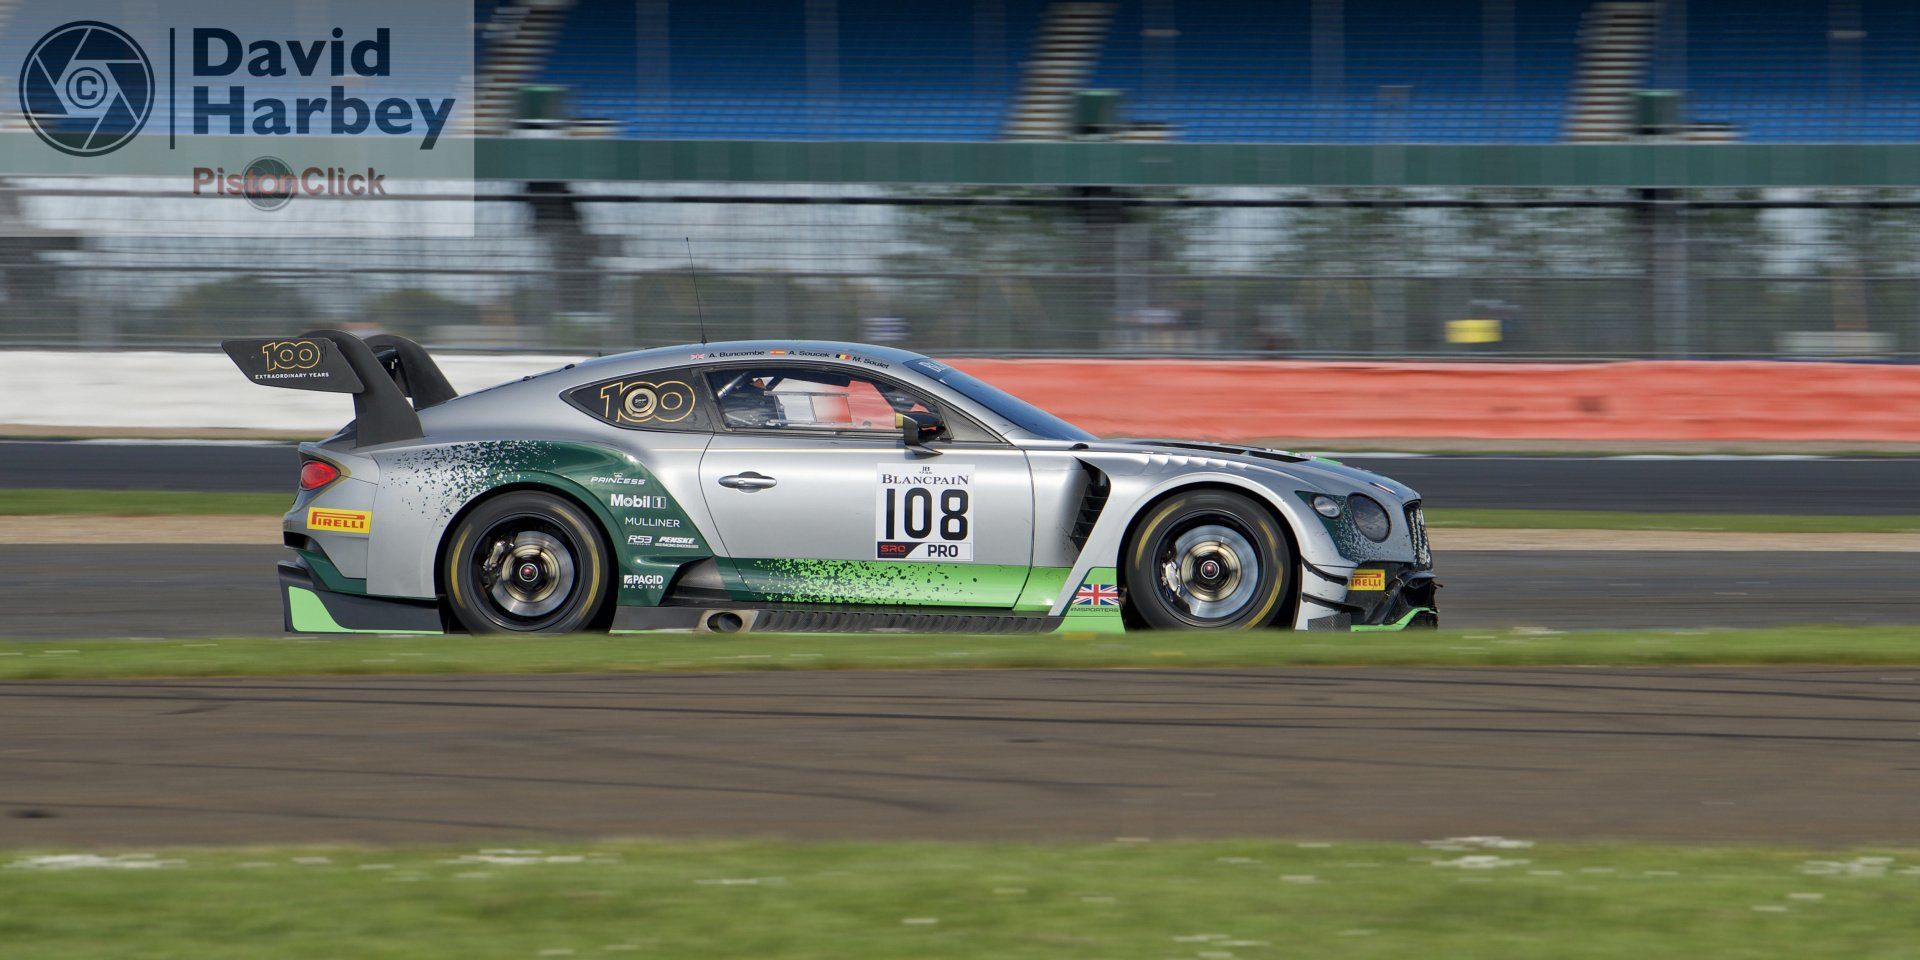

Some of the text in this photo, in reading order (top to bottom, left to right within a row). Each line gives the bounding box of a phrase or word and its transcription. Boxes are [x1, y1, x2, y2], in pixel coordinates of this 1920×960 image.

[262, 341, 320, 371] 100
[719, 350, 765, 358] Buncombe
[799, 350, 830, 358] Soucek
[863, 359, 890, 369] Soulet
[255, 372, 307, 380] EXTRAORDINARY
[600, 381, 696, 423] 100
[590, 476, 646, 485] PRINCESS
[882, 474, 969, 485] BLANCPAIN
[610, 494, 651, 509] Mobil
[885, 487, 969, 541] 108
[311, 511, 365, 529] PIRELLI
[624, 516, 680, 528] MULLINER
[658, 536, 695, 544] PENSKE
[880, 545, 906, 553] SRO
[927, 544, 959, 558] PRO
[633, 575, 664, 585] PAGID
